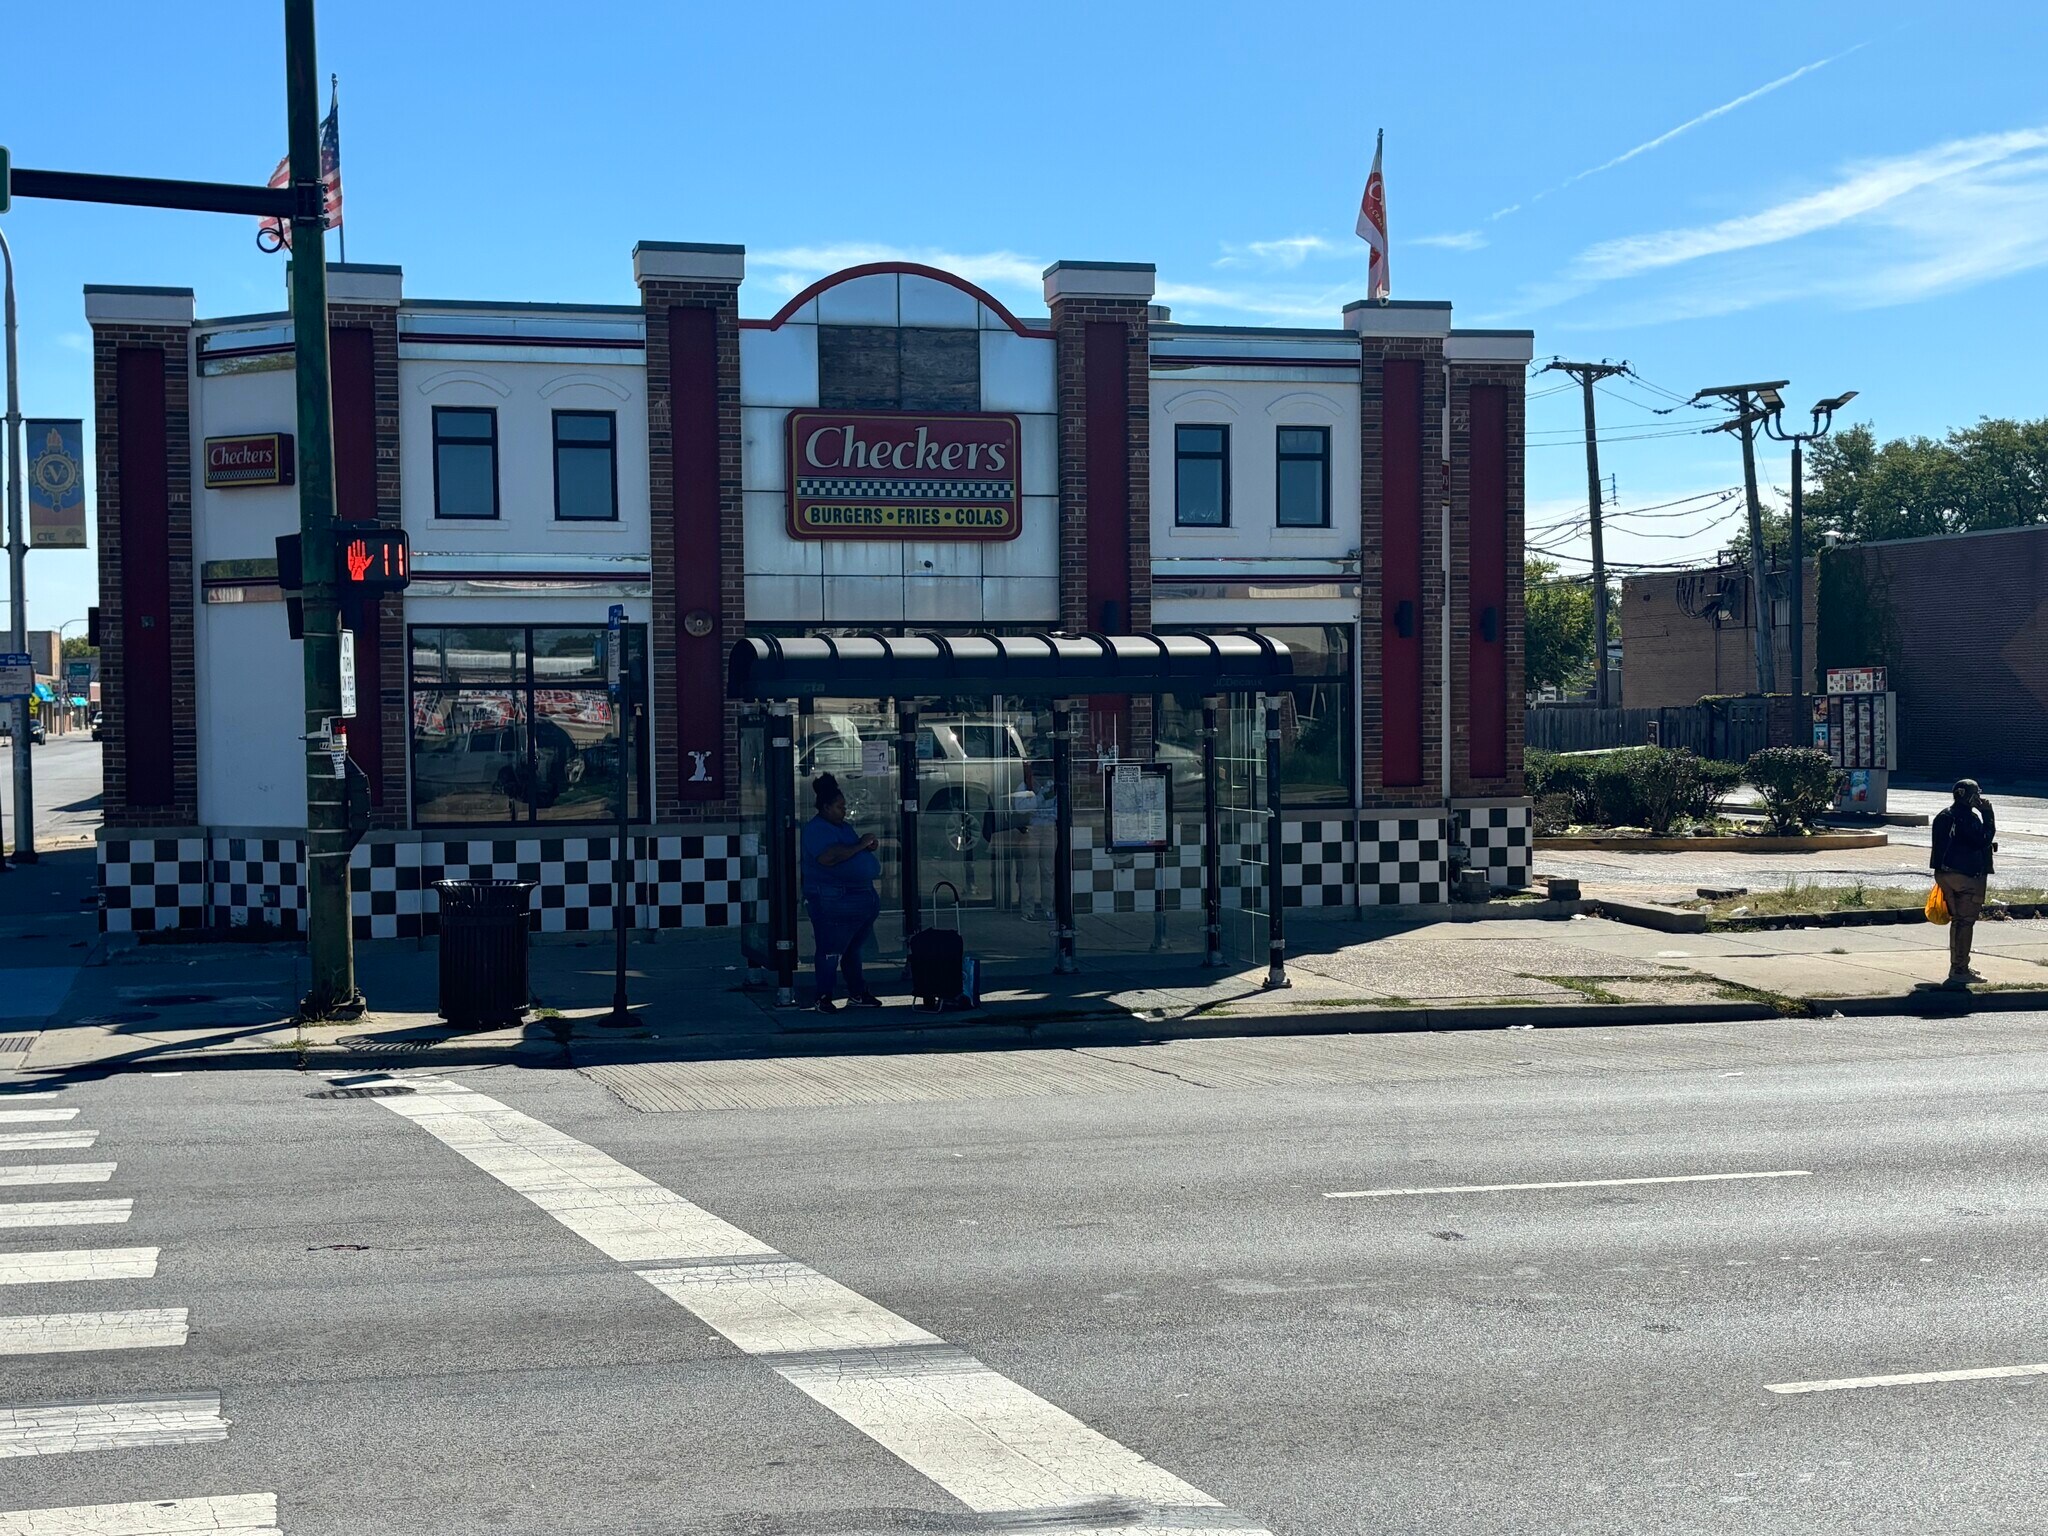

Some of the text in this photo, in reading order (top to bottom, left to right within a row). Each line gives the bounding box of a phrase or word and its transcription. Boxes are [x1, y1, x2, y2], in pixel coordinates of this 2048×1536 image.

[210, 445, 272, 466] Checkers
[805, 425, 1006, 472] Checkers
[47, 465, 65, 482] V
[810, 506, 1003, 525] BURGERS FRIES COLAS
[384, 544, 403, 576] 11
